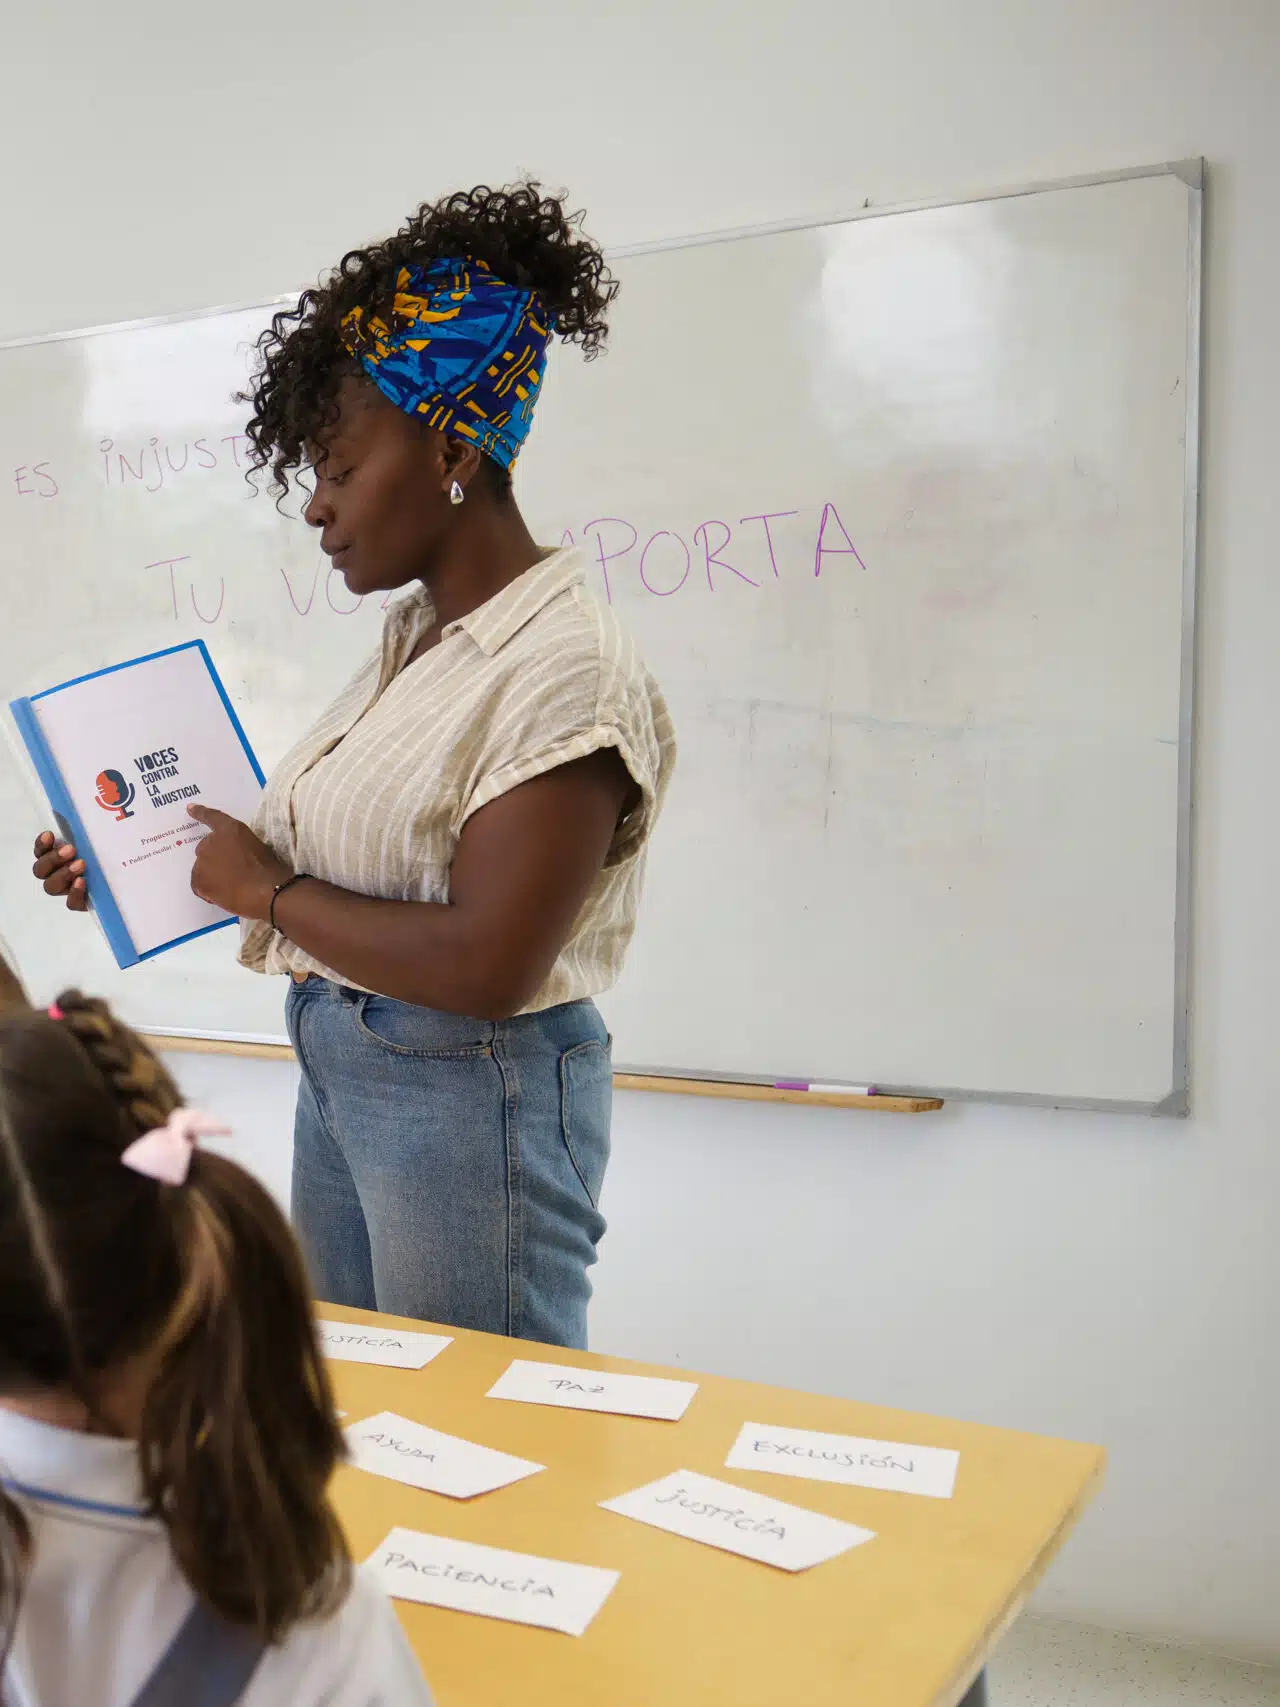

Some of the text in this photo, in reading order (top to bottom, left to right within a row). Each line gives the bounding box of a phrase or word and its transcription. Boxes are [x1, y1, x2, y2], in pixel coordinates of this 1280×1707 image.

[14, 461, 58, 498] ES
[144, 503, 867, 624] TU VO PORTA
[134, 747, 179, 773] VOCES
[141, 765, 179, 785] CONTRA
[146, 784, 160, 797] LA
[151, 784, 201, 808] INJUSTICIA
[141, 821, 200, 846] Propuesta colabor
[549, 1379, 605, 1394] PAZ
[362, 1432, 436, 1463] AYUDA
